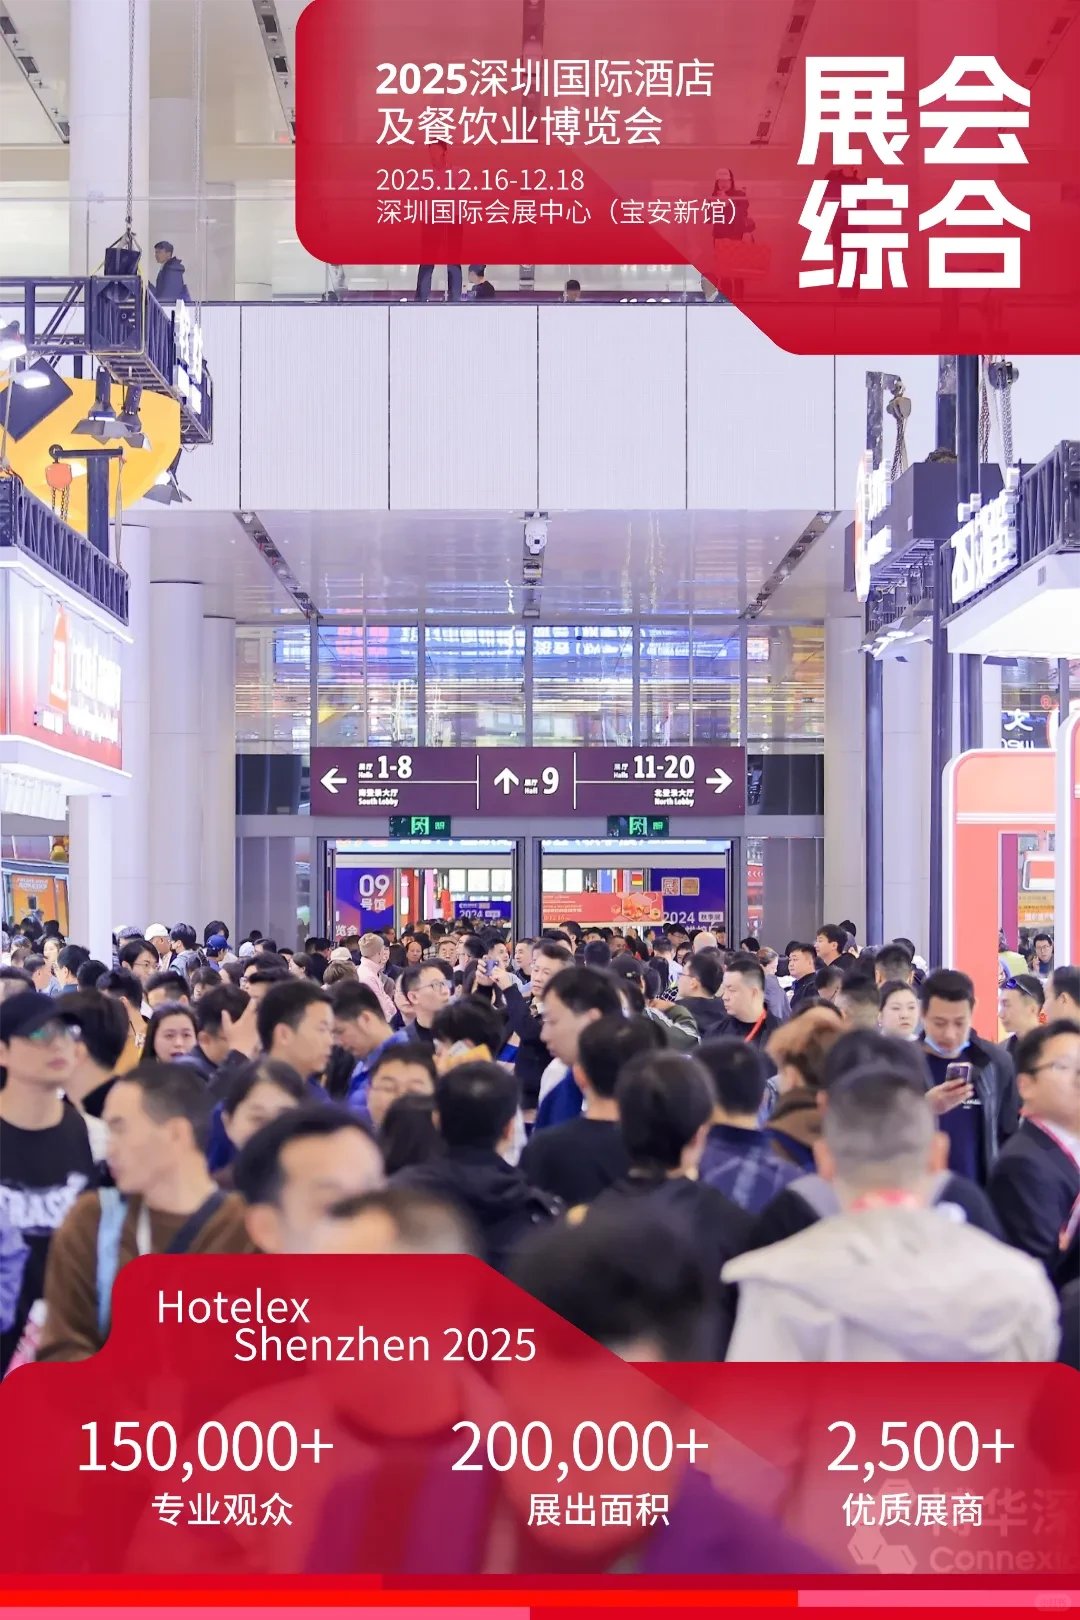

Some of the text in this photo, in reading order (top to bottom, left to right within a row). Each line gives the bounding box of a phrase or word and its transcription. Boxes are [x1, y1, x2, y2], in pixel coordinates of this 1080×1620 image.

[378, 755, 413, 779] 1-8
[634, 754, 695, 779] 11-20
[542, 766, 560, 795] 9
[358, 797, 399, 808] South Lobby
[654, 797, 695, 808] North Lobby
[359, 874, 390, 897] 09
[360, 898, 386, 911] 号馆
[663, 911, 696, 924] 2024
